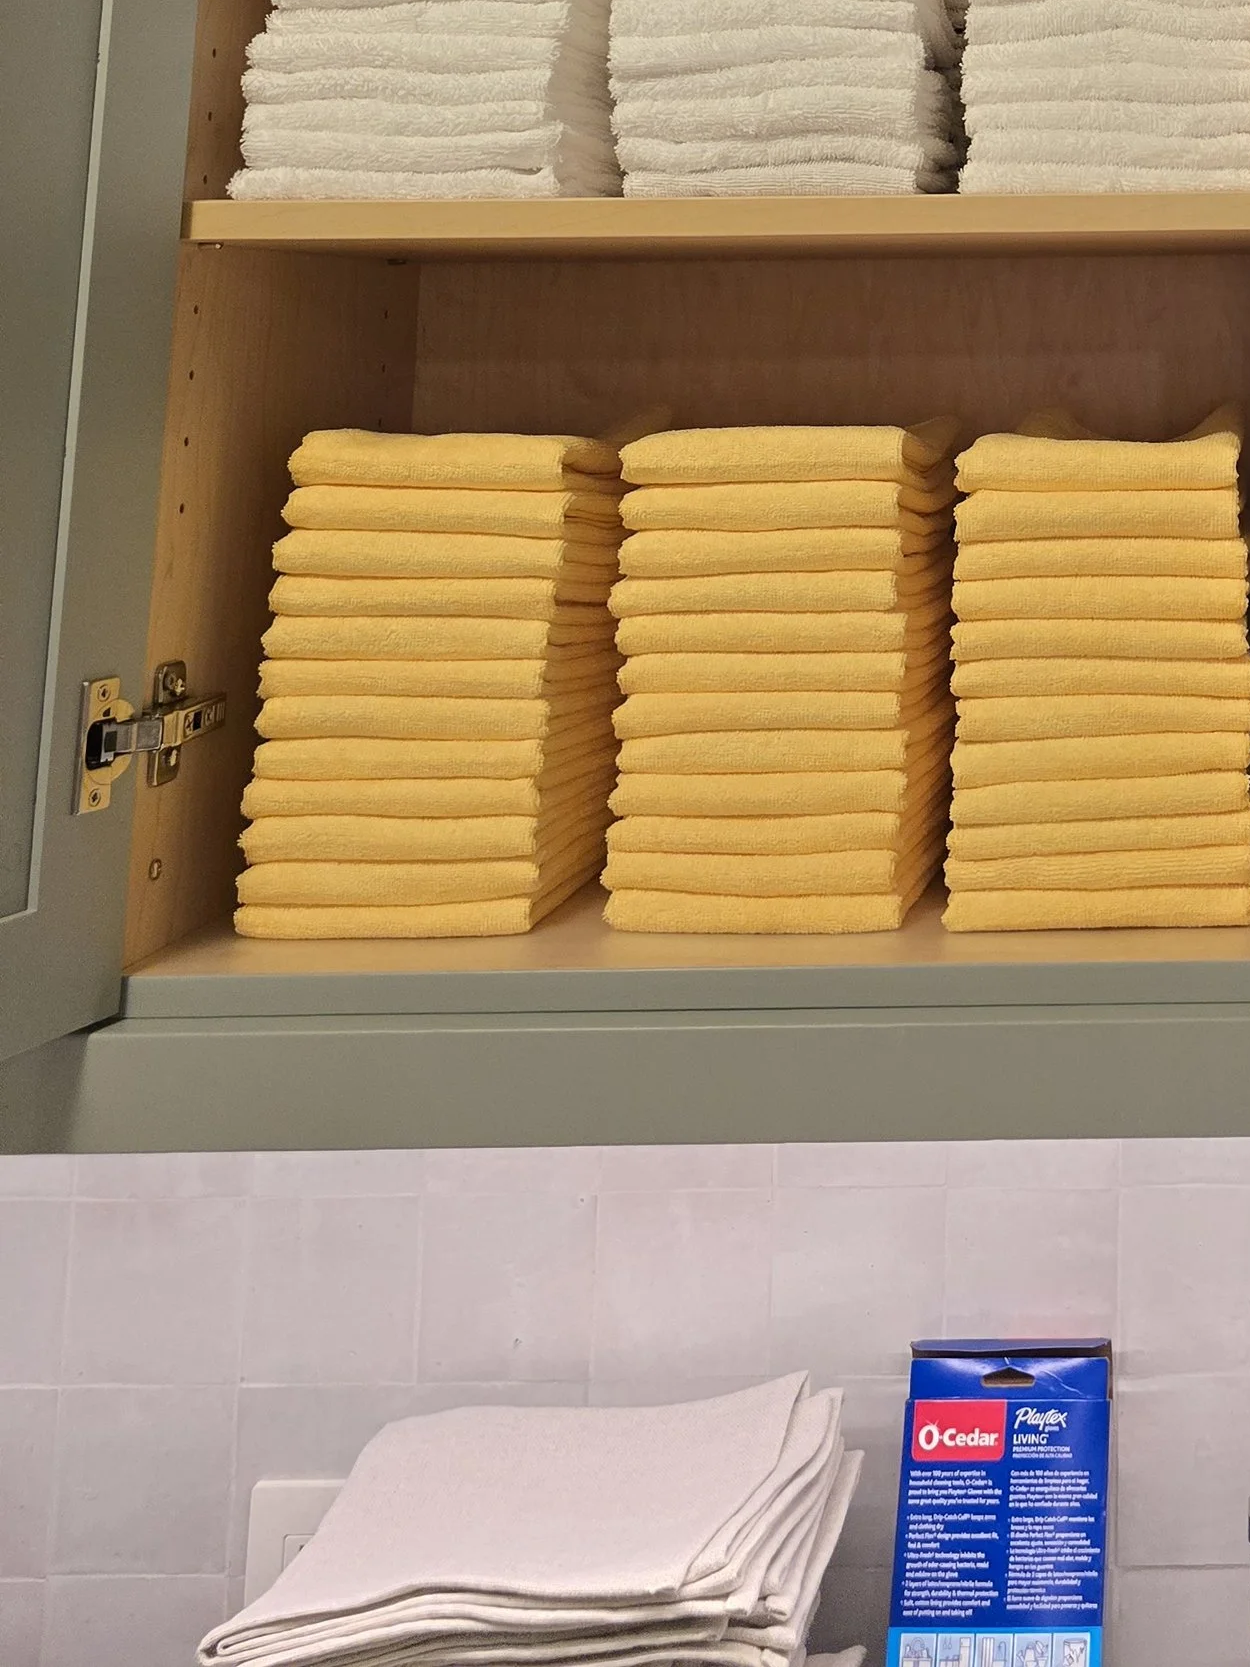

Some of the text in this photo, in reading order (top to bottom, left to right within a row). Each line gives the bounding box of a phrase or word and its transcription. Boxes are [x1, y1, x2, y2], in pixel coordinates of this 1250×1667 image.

[1013, 1407, 1068, 1431] Playtex
[918, 1422, 998, 1451] O-Cedar
[1013, 1433, 1048, 1445] LIVING
